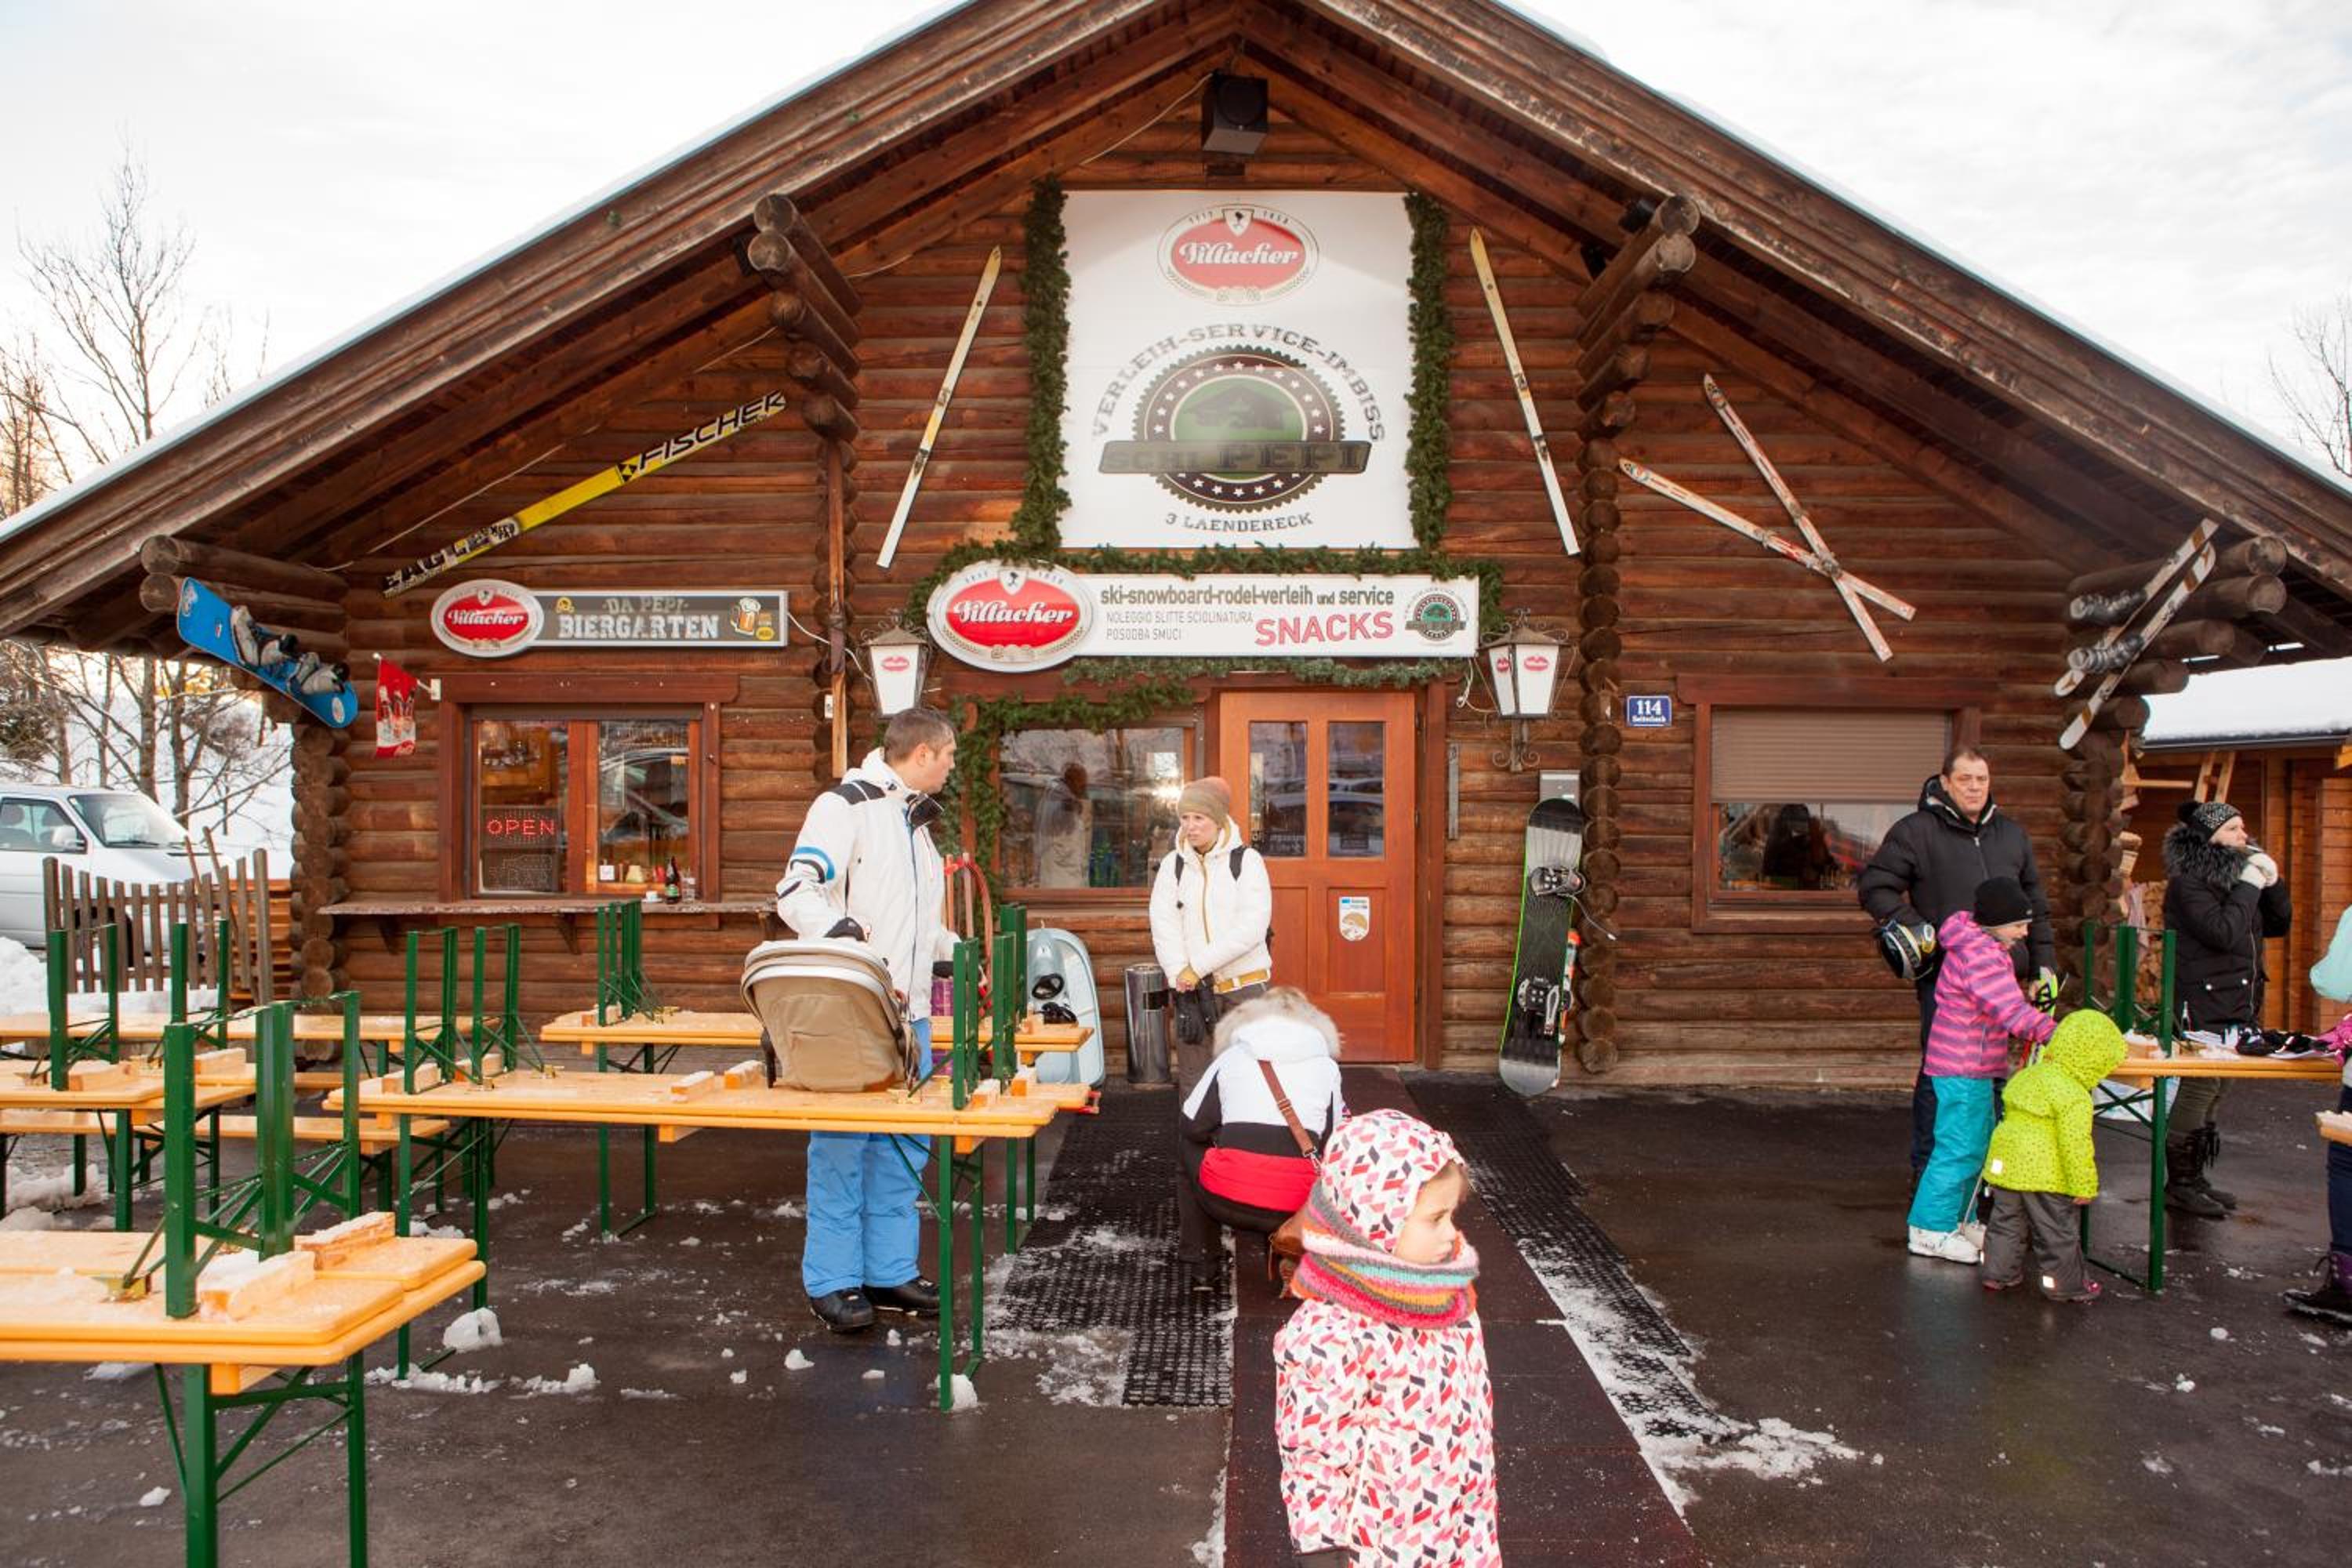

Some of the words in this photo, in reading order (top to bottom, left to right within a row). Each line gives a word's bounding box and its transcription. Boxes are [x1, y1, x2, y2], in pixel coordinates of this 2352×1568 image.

[1178, 241, 1299, 265] Villacher
[640, 390, 786, 470] FISCHER
[1166, 513, 1178, 524] 3
[1183, 512, 1314, 532] LAENDERECK
[1317, 590, 1334, 604] und
[1338, 586, 1394, 604] service
[607, 597, 634, 614] DA
[640, 597, 684, 614] PEPI
[953, 600, 1073, 623] Villacher
[448, 608, 524, 626] Villacher
[1106, 612, 1152, 623] NOLEGGIO
[1155, 612, 1185, 623] SLITTE
[558, 615, 720, 639] BIERGARTEN
[1254, 611, 1394, 646] SNACKS
[1636, 699, 1661, 715] 114
[488, 819, 554, 835] OPEN
